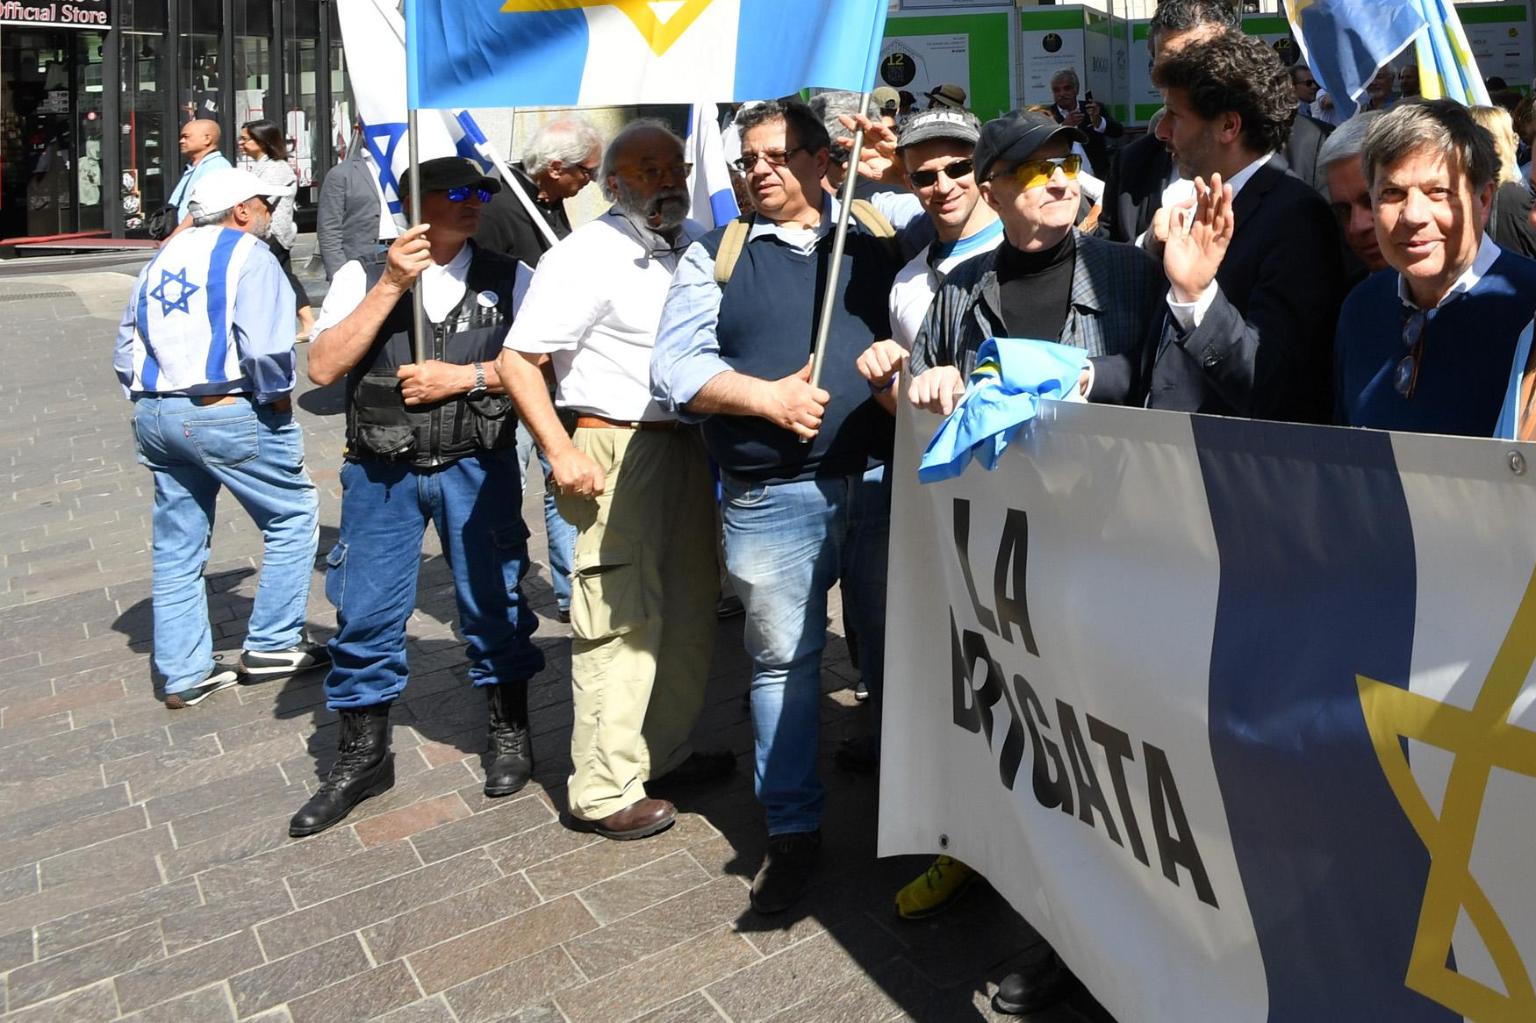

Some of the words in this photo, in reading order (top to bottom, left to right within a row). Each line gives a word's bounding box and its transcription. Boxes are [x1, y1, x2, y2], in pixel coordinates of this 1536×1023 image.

[61, 4, 107, 24] Store
[887, 53, 904, 66] 12
[953, 497, 1040, 658] LA
